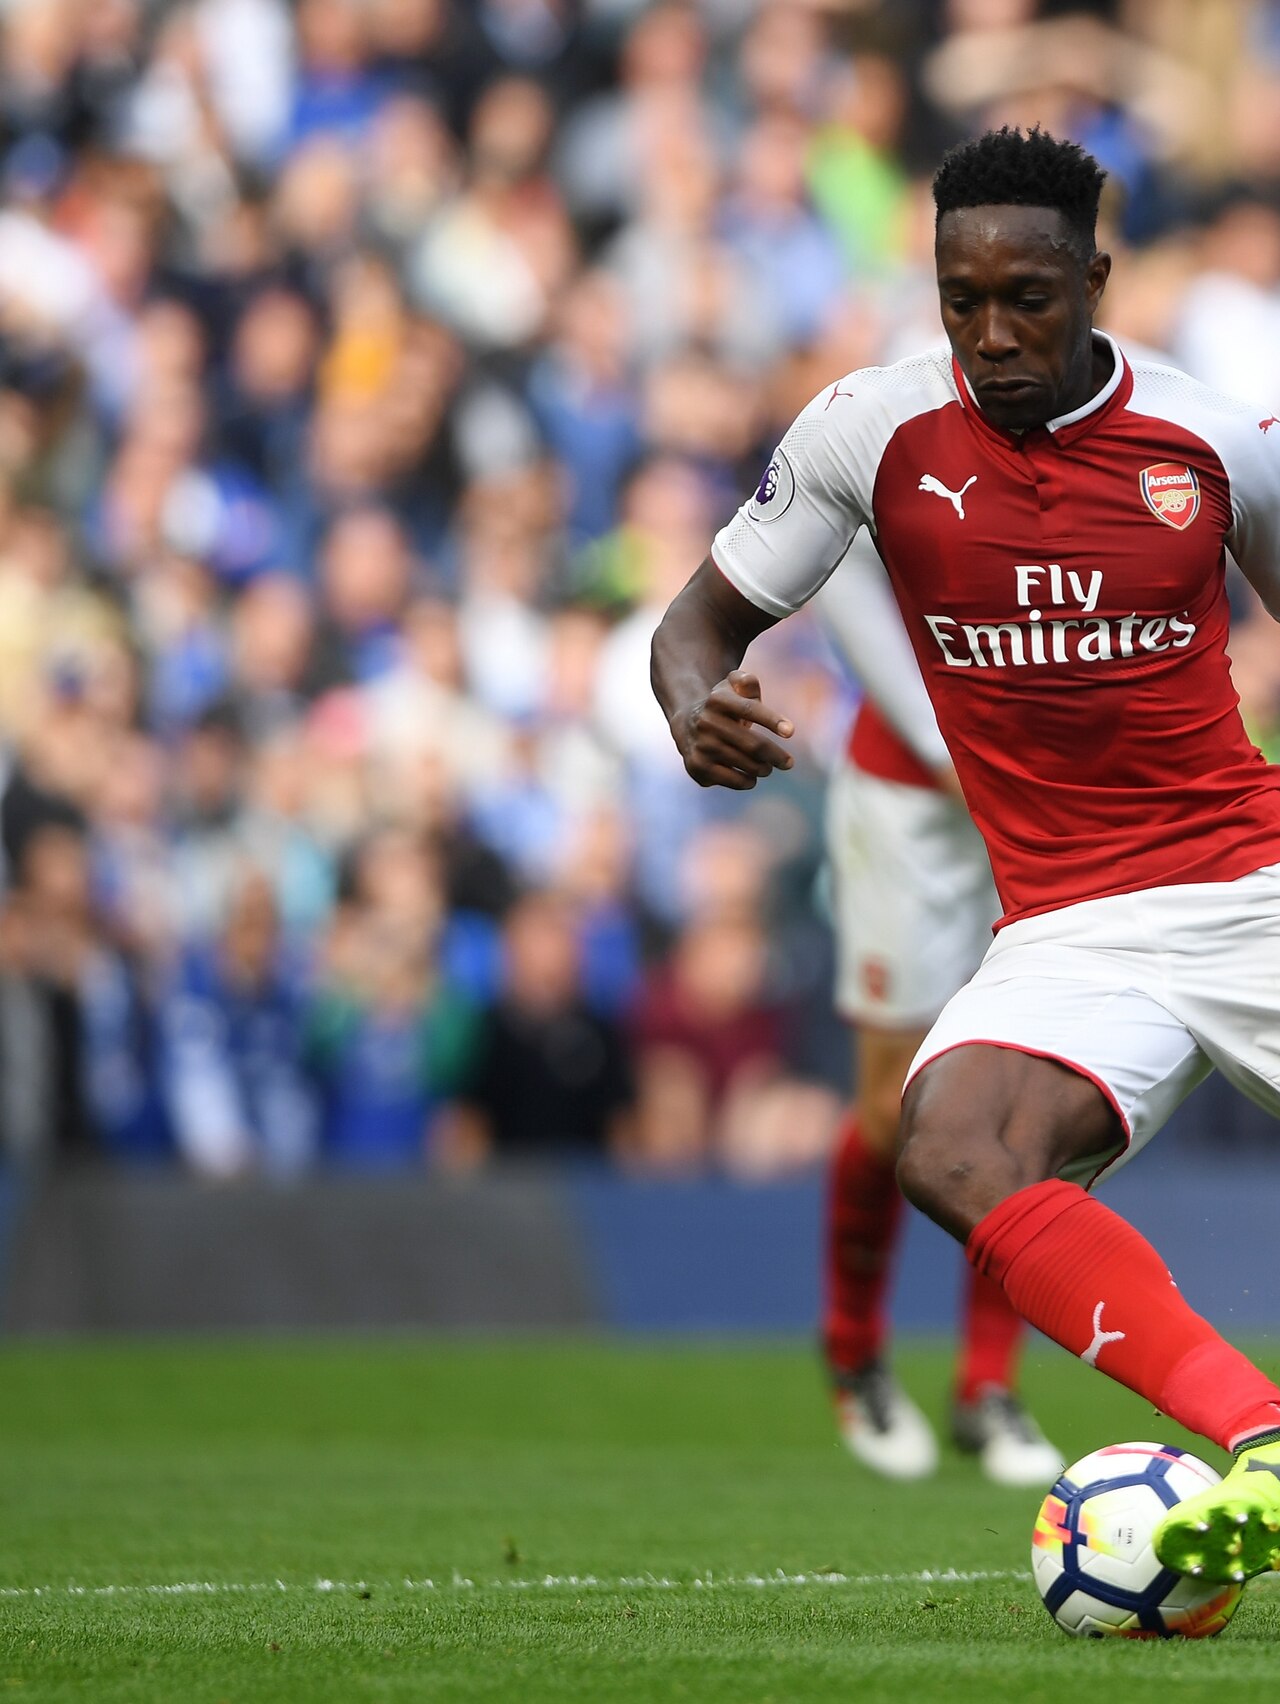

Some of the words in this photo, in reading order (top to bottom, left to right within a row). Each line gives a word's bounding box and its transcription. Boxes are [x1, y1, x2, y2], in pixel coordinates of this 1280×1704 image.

[1148, 472, 1192, 488] Arsenal
[1014, 564, 1103, 612] Fly
[923, 608, 1197, 667] Emirates
